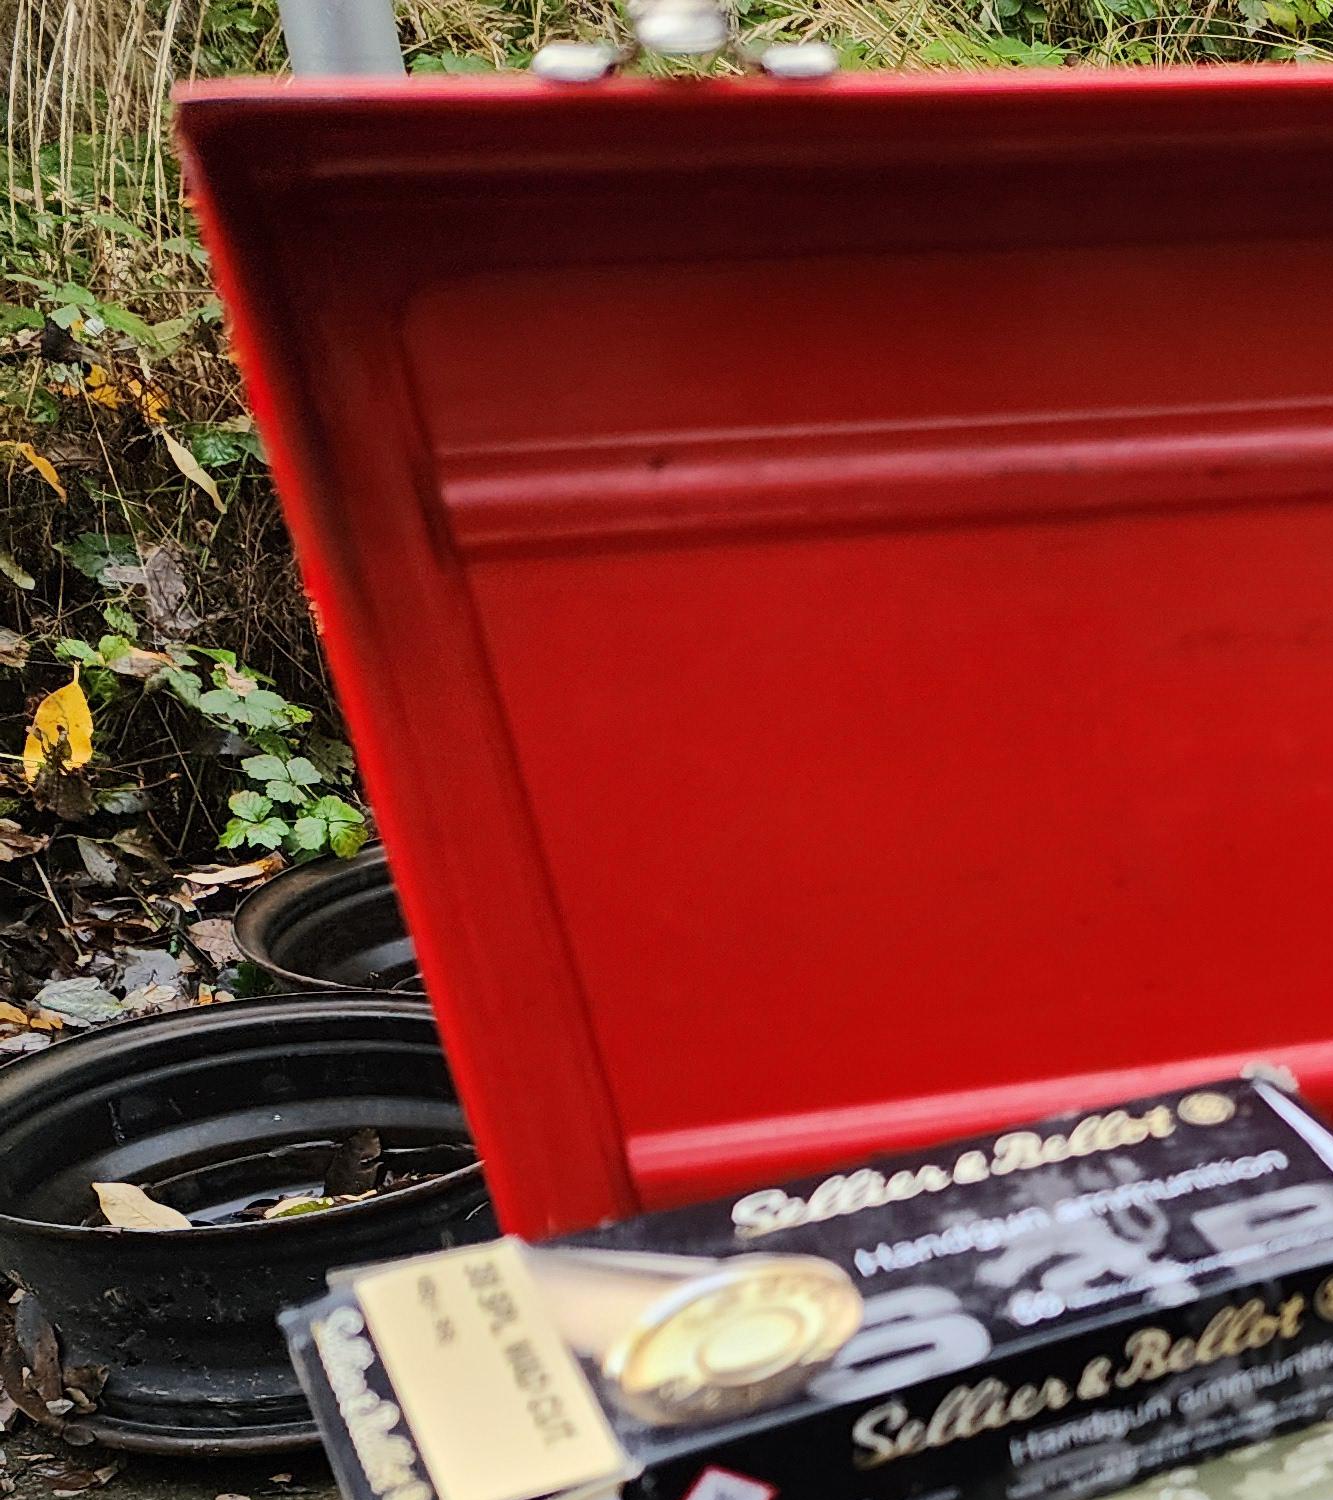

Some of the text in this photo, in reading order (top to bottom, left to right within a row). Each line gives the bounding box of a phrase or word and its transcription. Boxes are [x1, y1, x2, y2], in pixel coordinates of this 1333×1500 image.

[850, 1372, 1073, 1469] Sellier
[1069, 1355, 1118, 1401] &
[1116, 1293, 1306, 1389] Bellot
